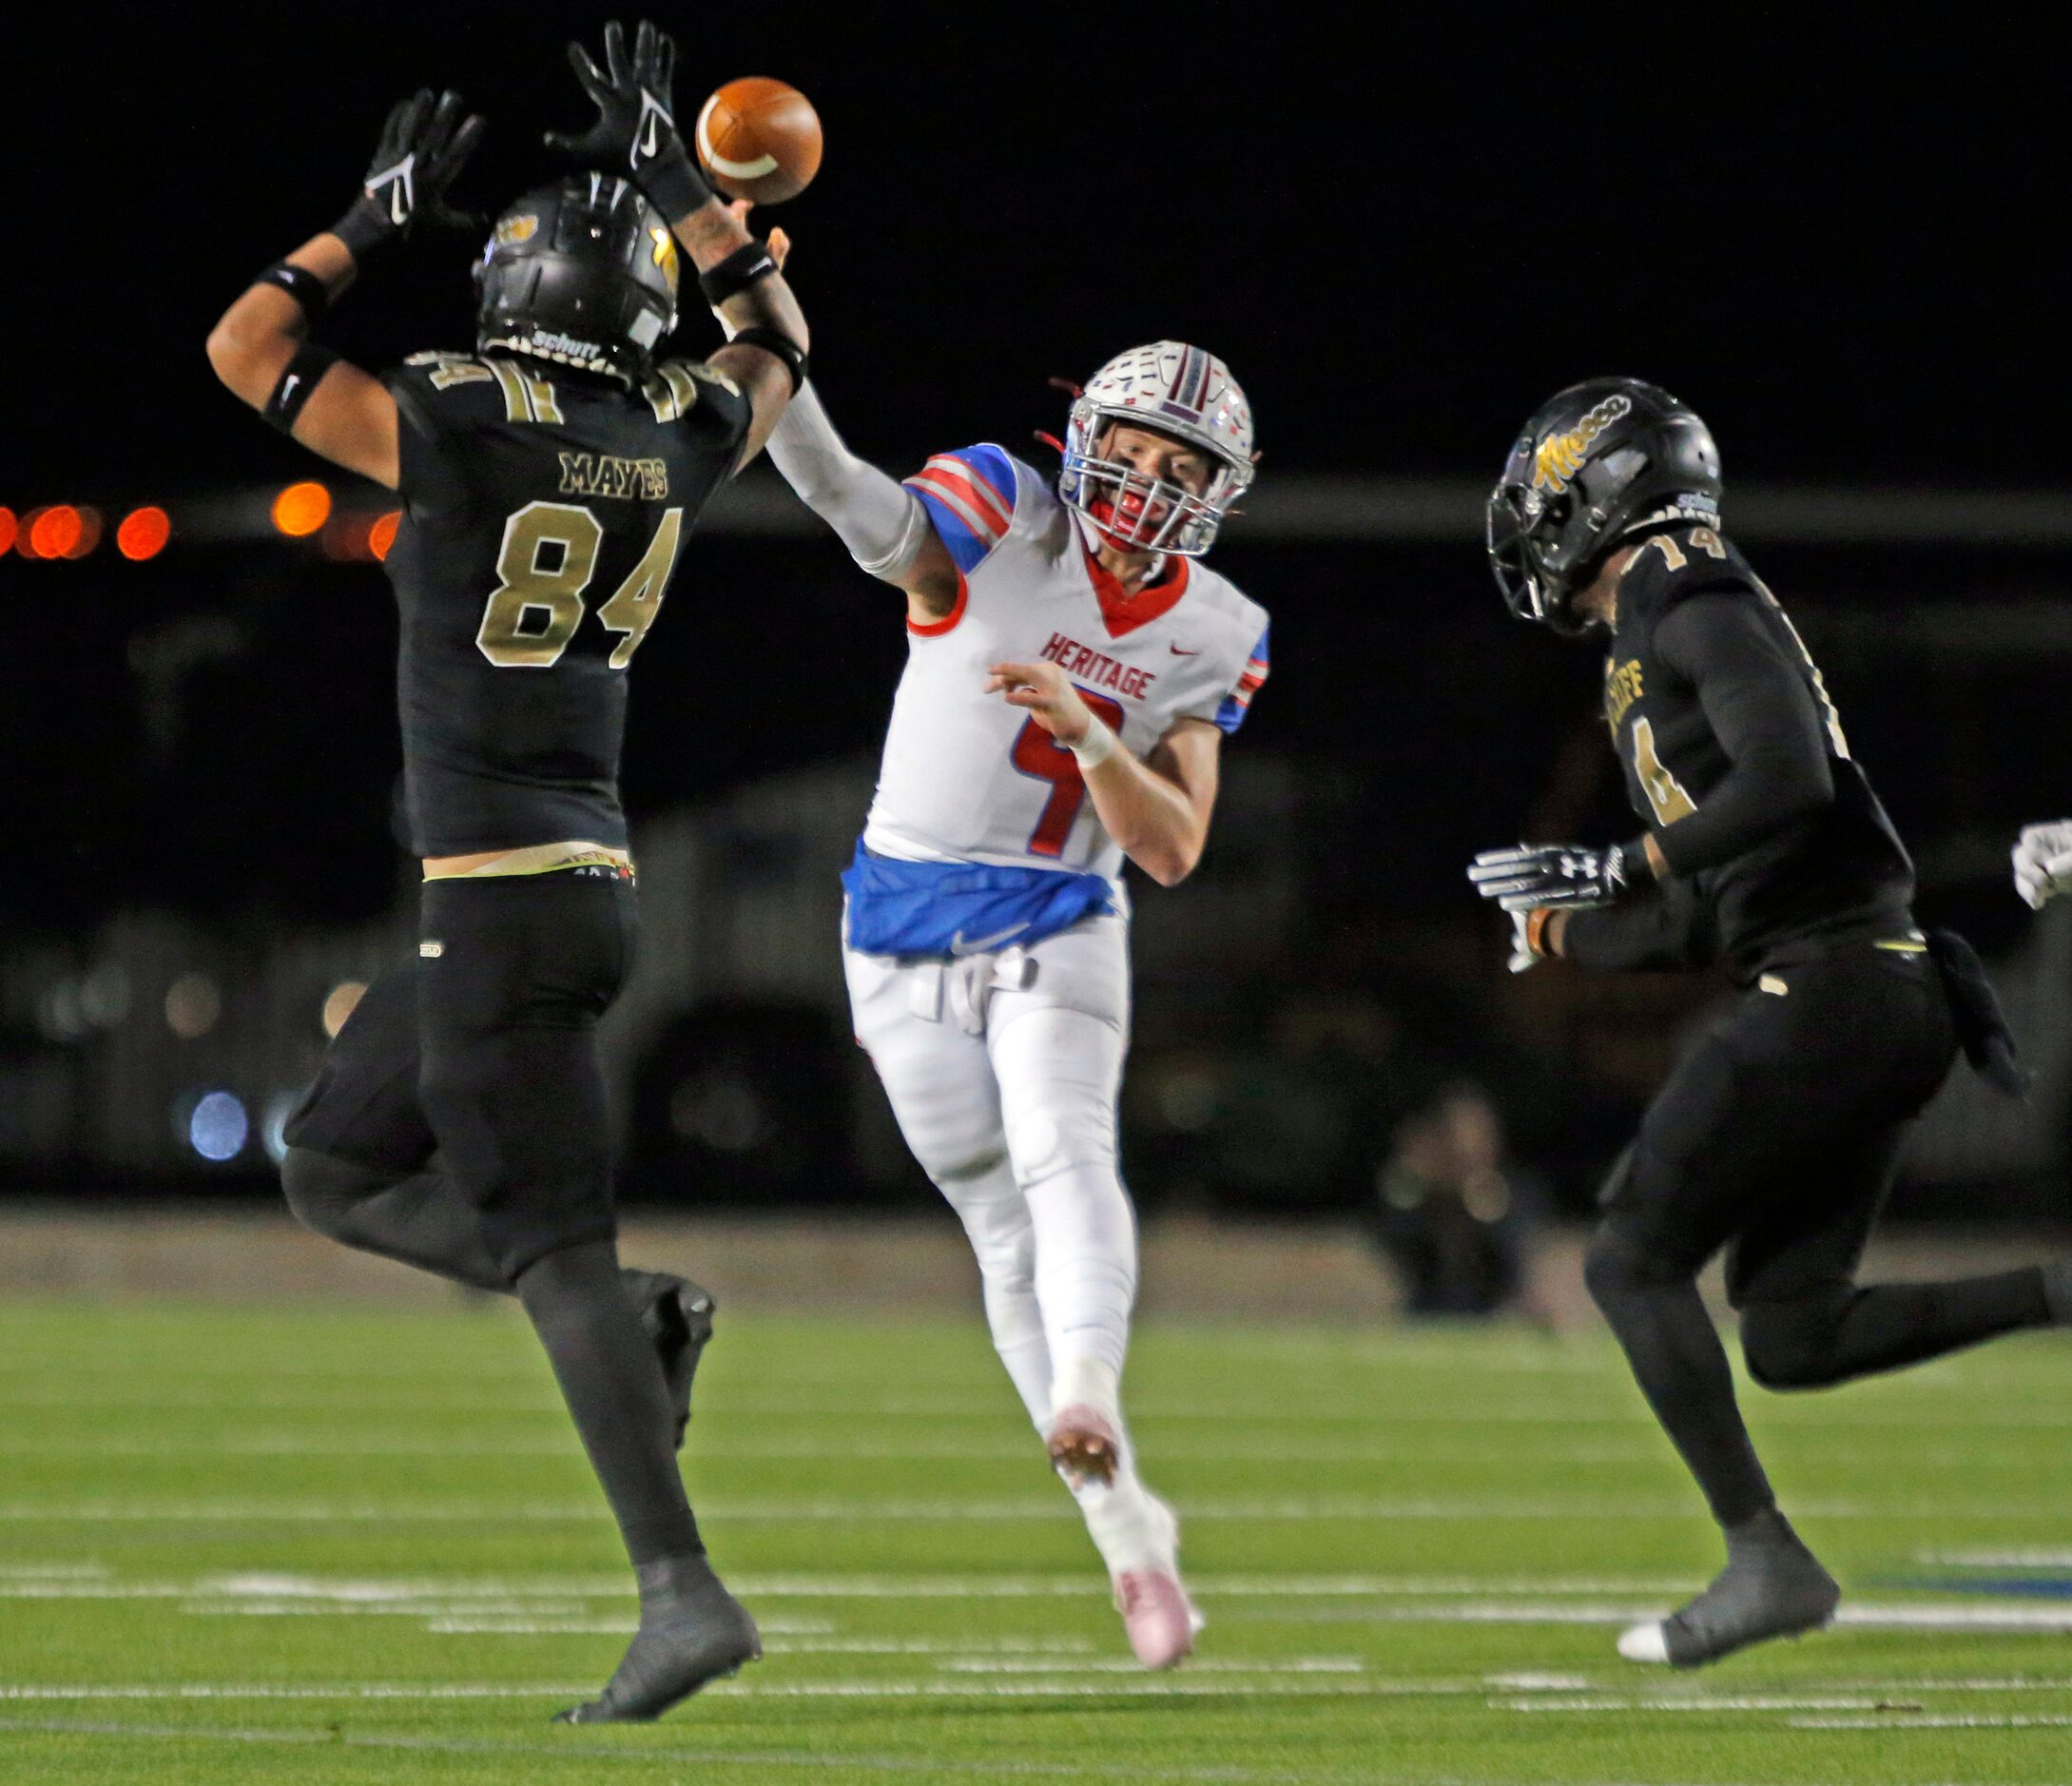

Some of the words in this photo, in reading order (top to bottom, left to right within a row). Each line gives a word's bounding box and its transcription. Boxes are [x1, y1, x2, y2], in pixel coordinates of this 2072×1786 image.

[558, 452, 668, 499] MAYES
[475, 500, 684, 669] 84
[1040, 631, 1156, 701] HERITAGE
